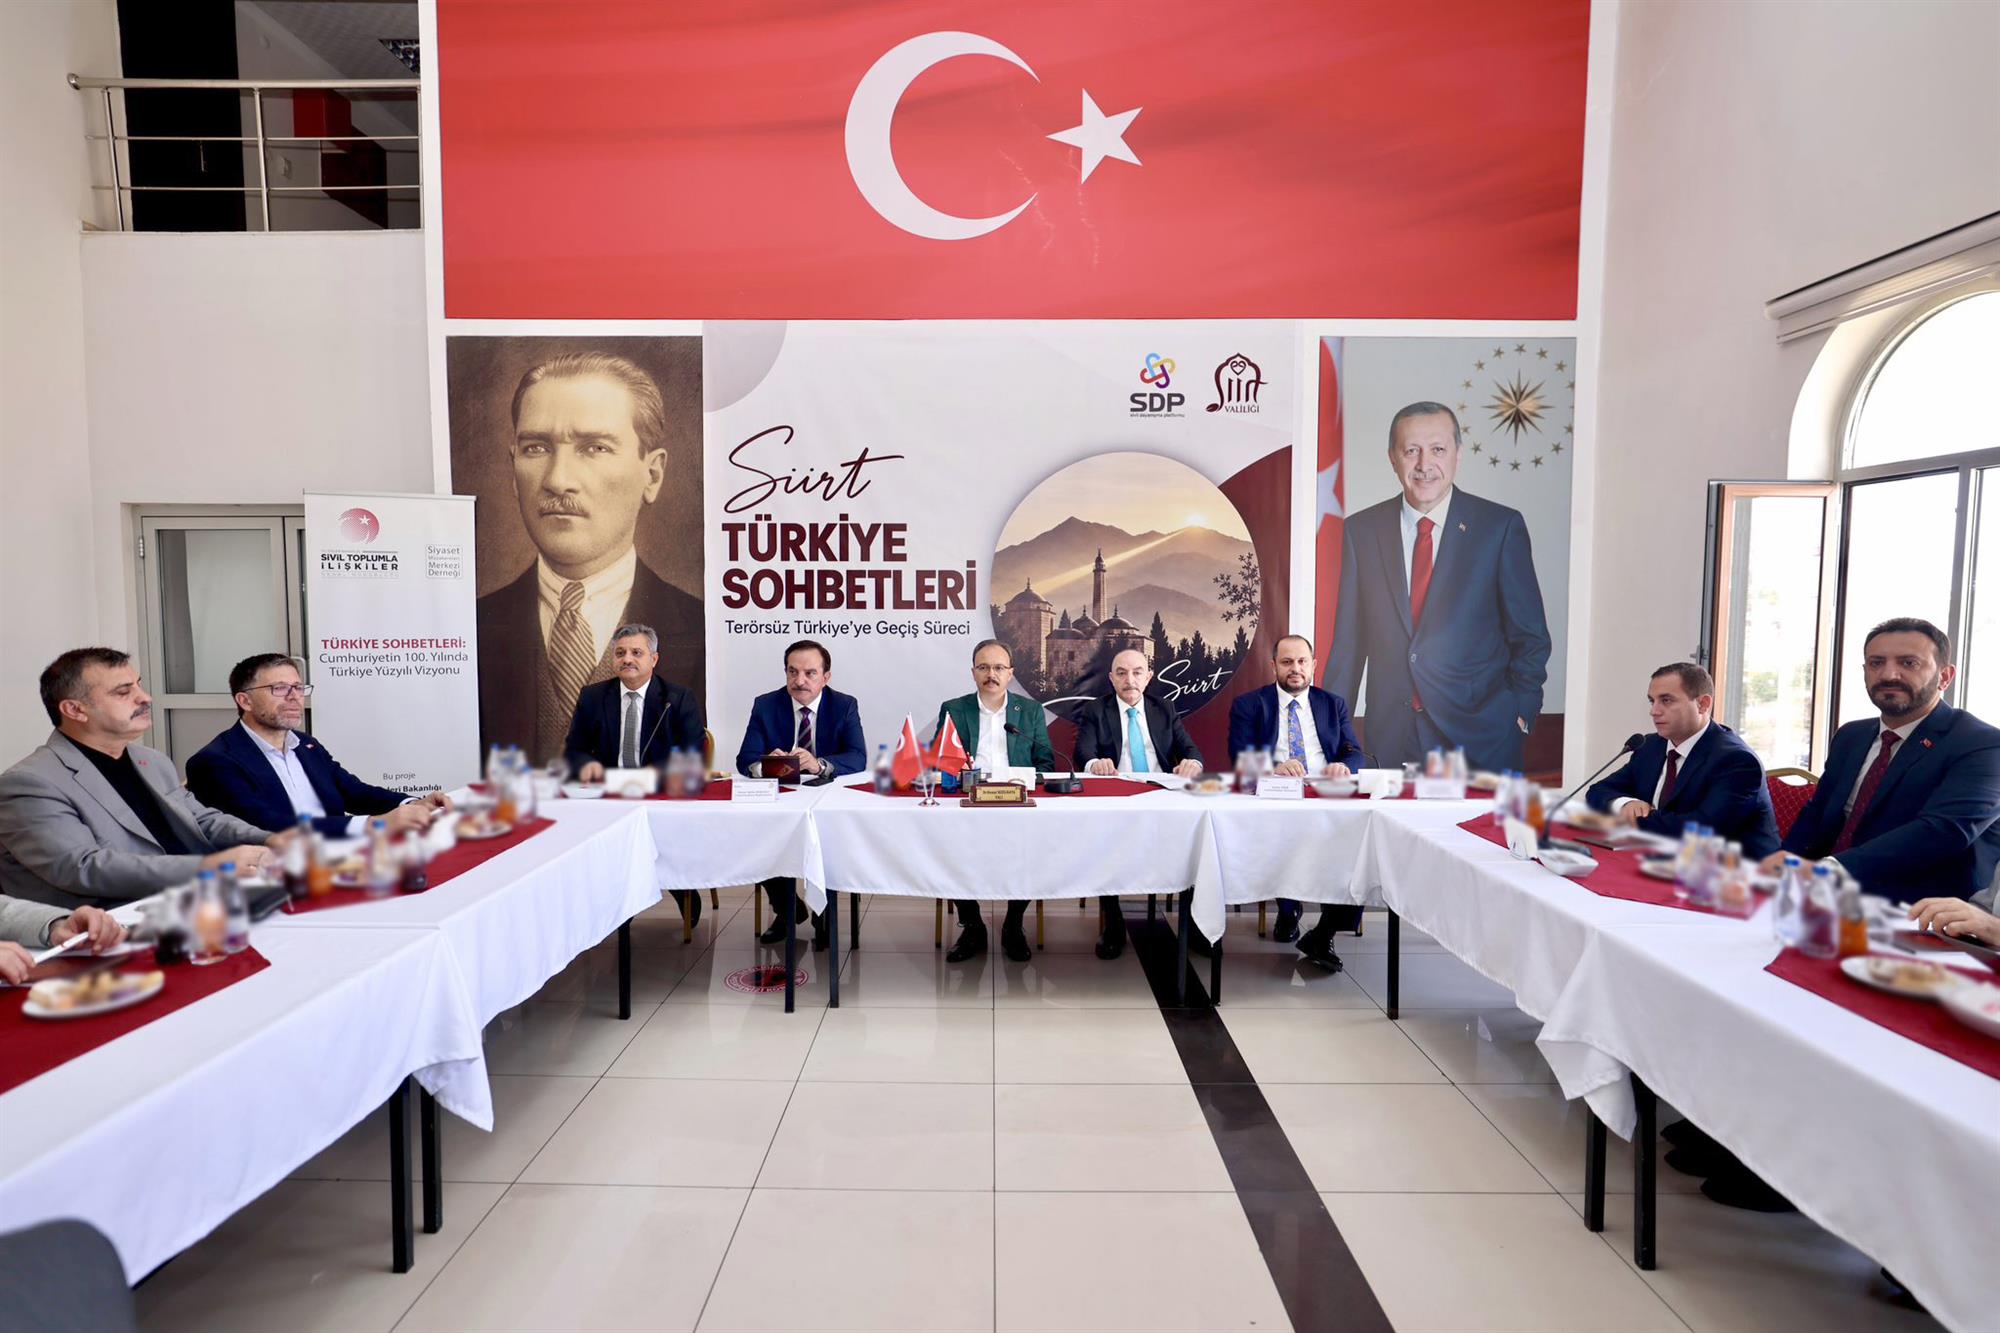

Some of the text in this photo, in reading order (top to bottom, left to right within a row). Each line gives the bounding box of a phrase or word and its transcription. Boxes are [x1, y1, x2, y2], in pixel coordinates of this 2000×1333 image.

[1130, 393, 1185, 412] SDP
[1224, 404, 1260, 413] VALİLİĞİ
[724, 425, 904, 513] Siirt
[722, 514, 907, 561] TÜRKİYE
[427, 545, 460, 555] Siyaset
[347, 554, 398, 562] TOPLUMLA
[722, 560, 976, 609] SOHBETLERİ
[725, 620, 790, 634] Terörsüz
[876, 620, 919, 638] Geçiş
[924, 620, 970, 635] Süreci
[321, 636, 466, 649] TÜRKİYE SOHBETLERİ:
[319, 651, 468, 665] Cumhuriyetin 100. Yılında
[329, 665, 460, 678] Türkiye Yüzyılı Vizyonu
[1157, 659, 1233, 701] Siirt
[395, 772, 416, 780] proje
[403, 784, 442, 792] Bakanlığı
